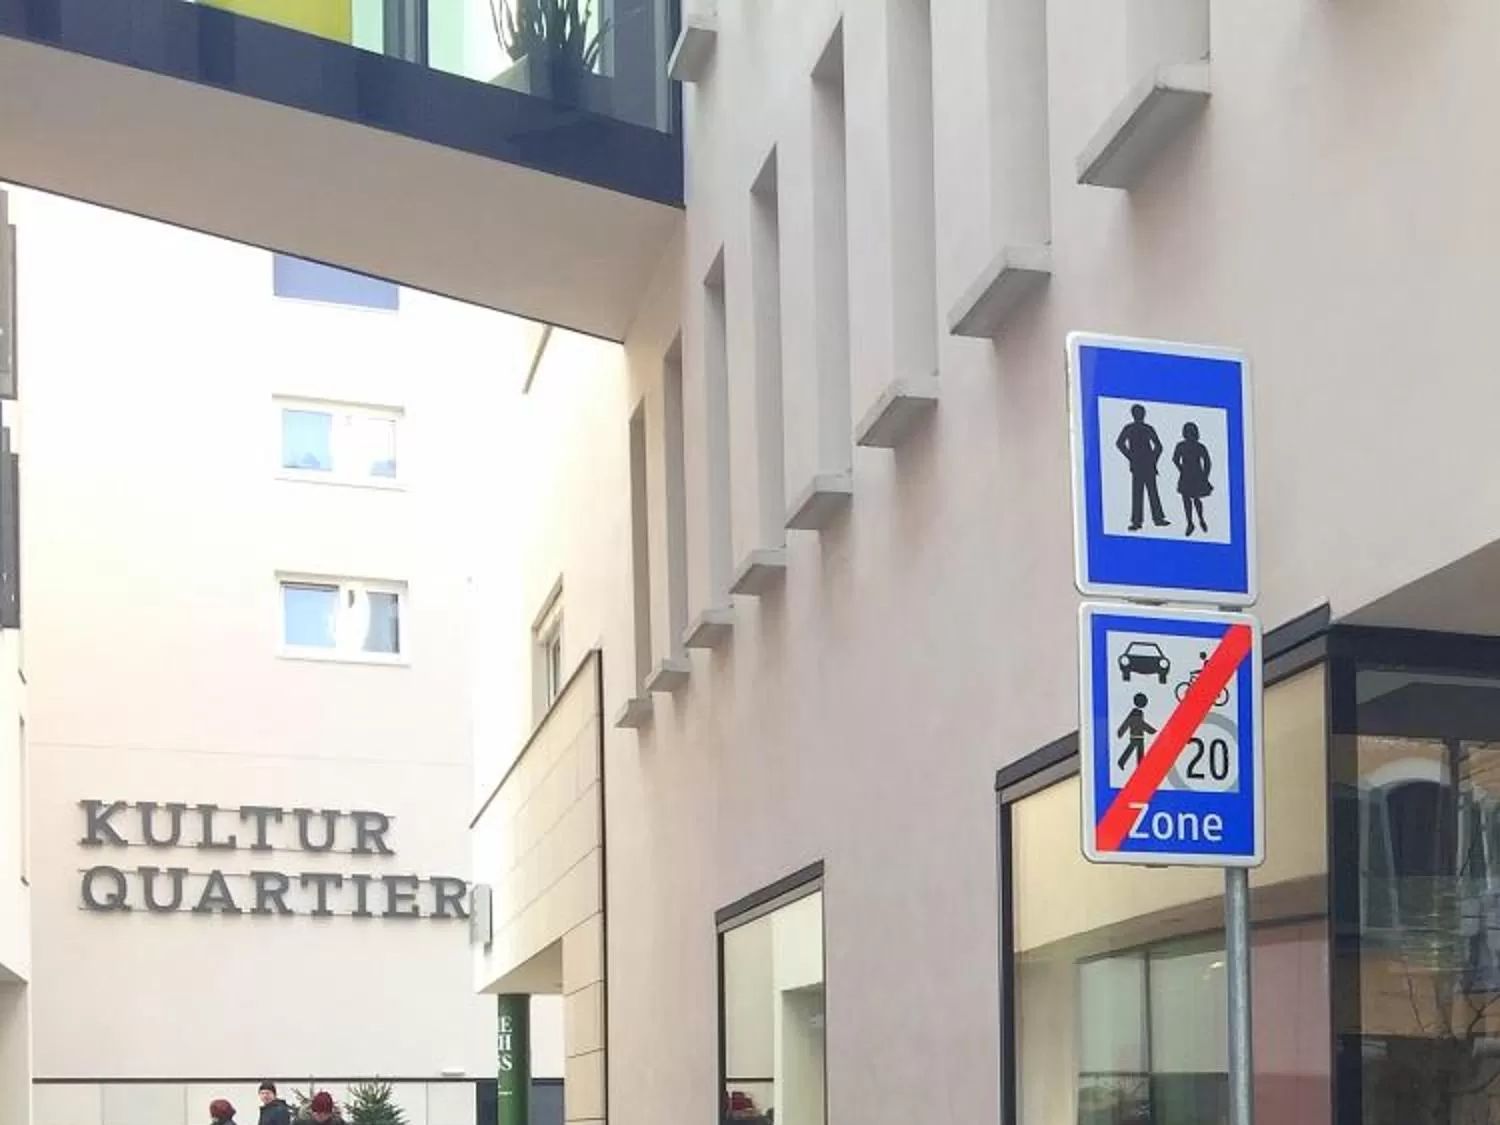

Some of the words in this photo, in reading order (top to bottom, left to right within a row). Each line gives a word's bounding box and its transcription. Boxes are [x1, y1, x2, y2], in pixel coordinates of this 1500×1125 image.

[1186, 736, 1229, 781] 20
[79, 799, 395, 856] KULTUR
[1127, 802, 1224, 842] Zone
[80, 864, 470, 919] QUARTIER
